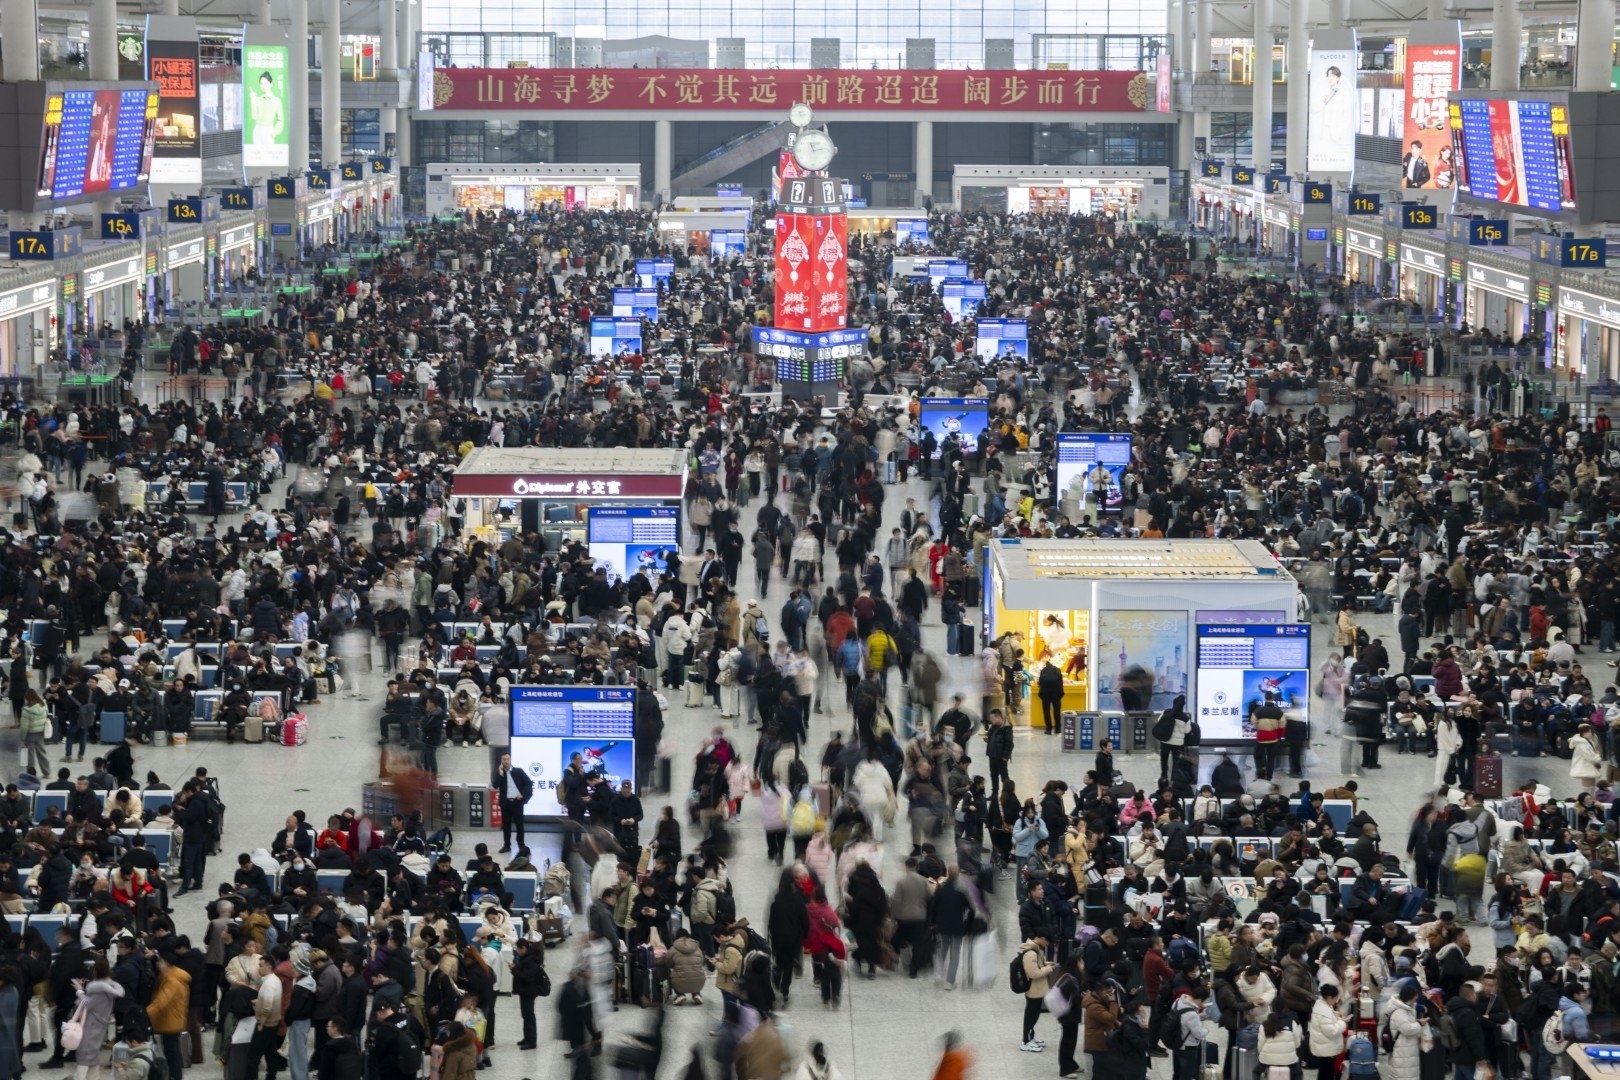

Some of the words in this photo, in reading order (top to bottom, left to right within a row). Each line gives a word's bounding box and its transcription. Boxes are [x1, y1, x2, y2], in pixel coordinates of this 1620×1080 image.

[154, 61, 192, 75] 小罐茶
[477, 74, 616, 104] 山海寻梦
[638, 74, 778, 104] 不觉其远
[801, 74, 940, 104] 前路迢迢
[964, 74, 1102, 105] 阔步而行
[1412, 75, 1453, 98] 就要
[1411, 98, 1450, 124] 小牛
[374, 161, 385, 171] 3A
[1208, 165, 1218, 174] 3B
[345, 168, 356, 177] 5A
[1238, 172, 1249, 181] 5B
[312, 174, 324, 185] 7A
[274, 183, 288, 195] 9A
[1311, 188, 1324, 199] 9B
[228, 193, 247, 205] 11A
[1354, 199, 1374, 210] 11B
[173, 204, 197, 218] 13A
[1408, 211, 1431, 223] 13B
[107, 219, 133, 233] 15A
[1476, 226, 1502, 239] 15B
[17, 238, 46, 254] 17A
[1569, 245, 1598, 261] 17B
[576, 480, 621, 494] 外交官
[1201, 706, 1240, 716] 泰兰尼斯
